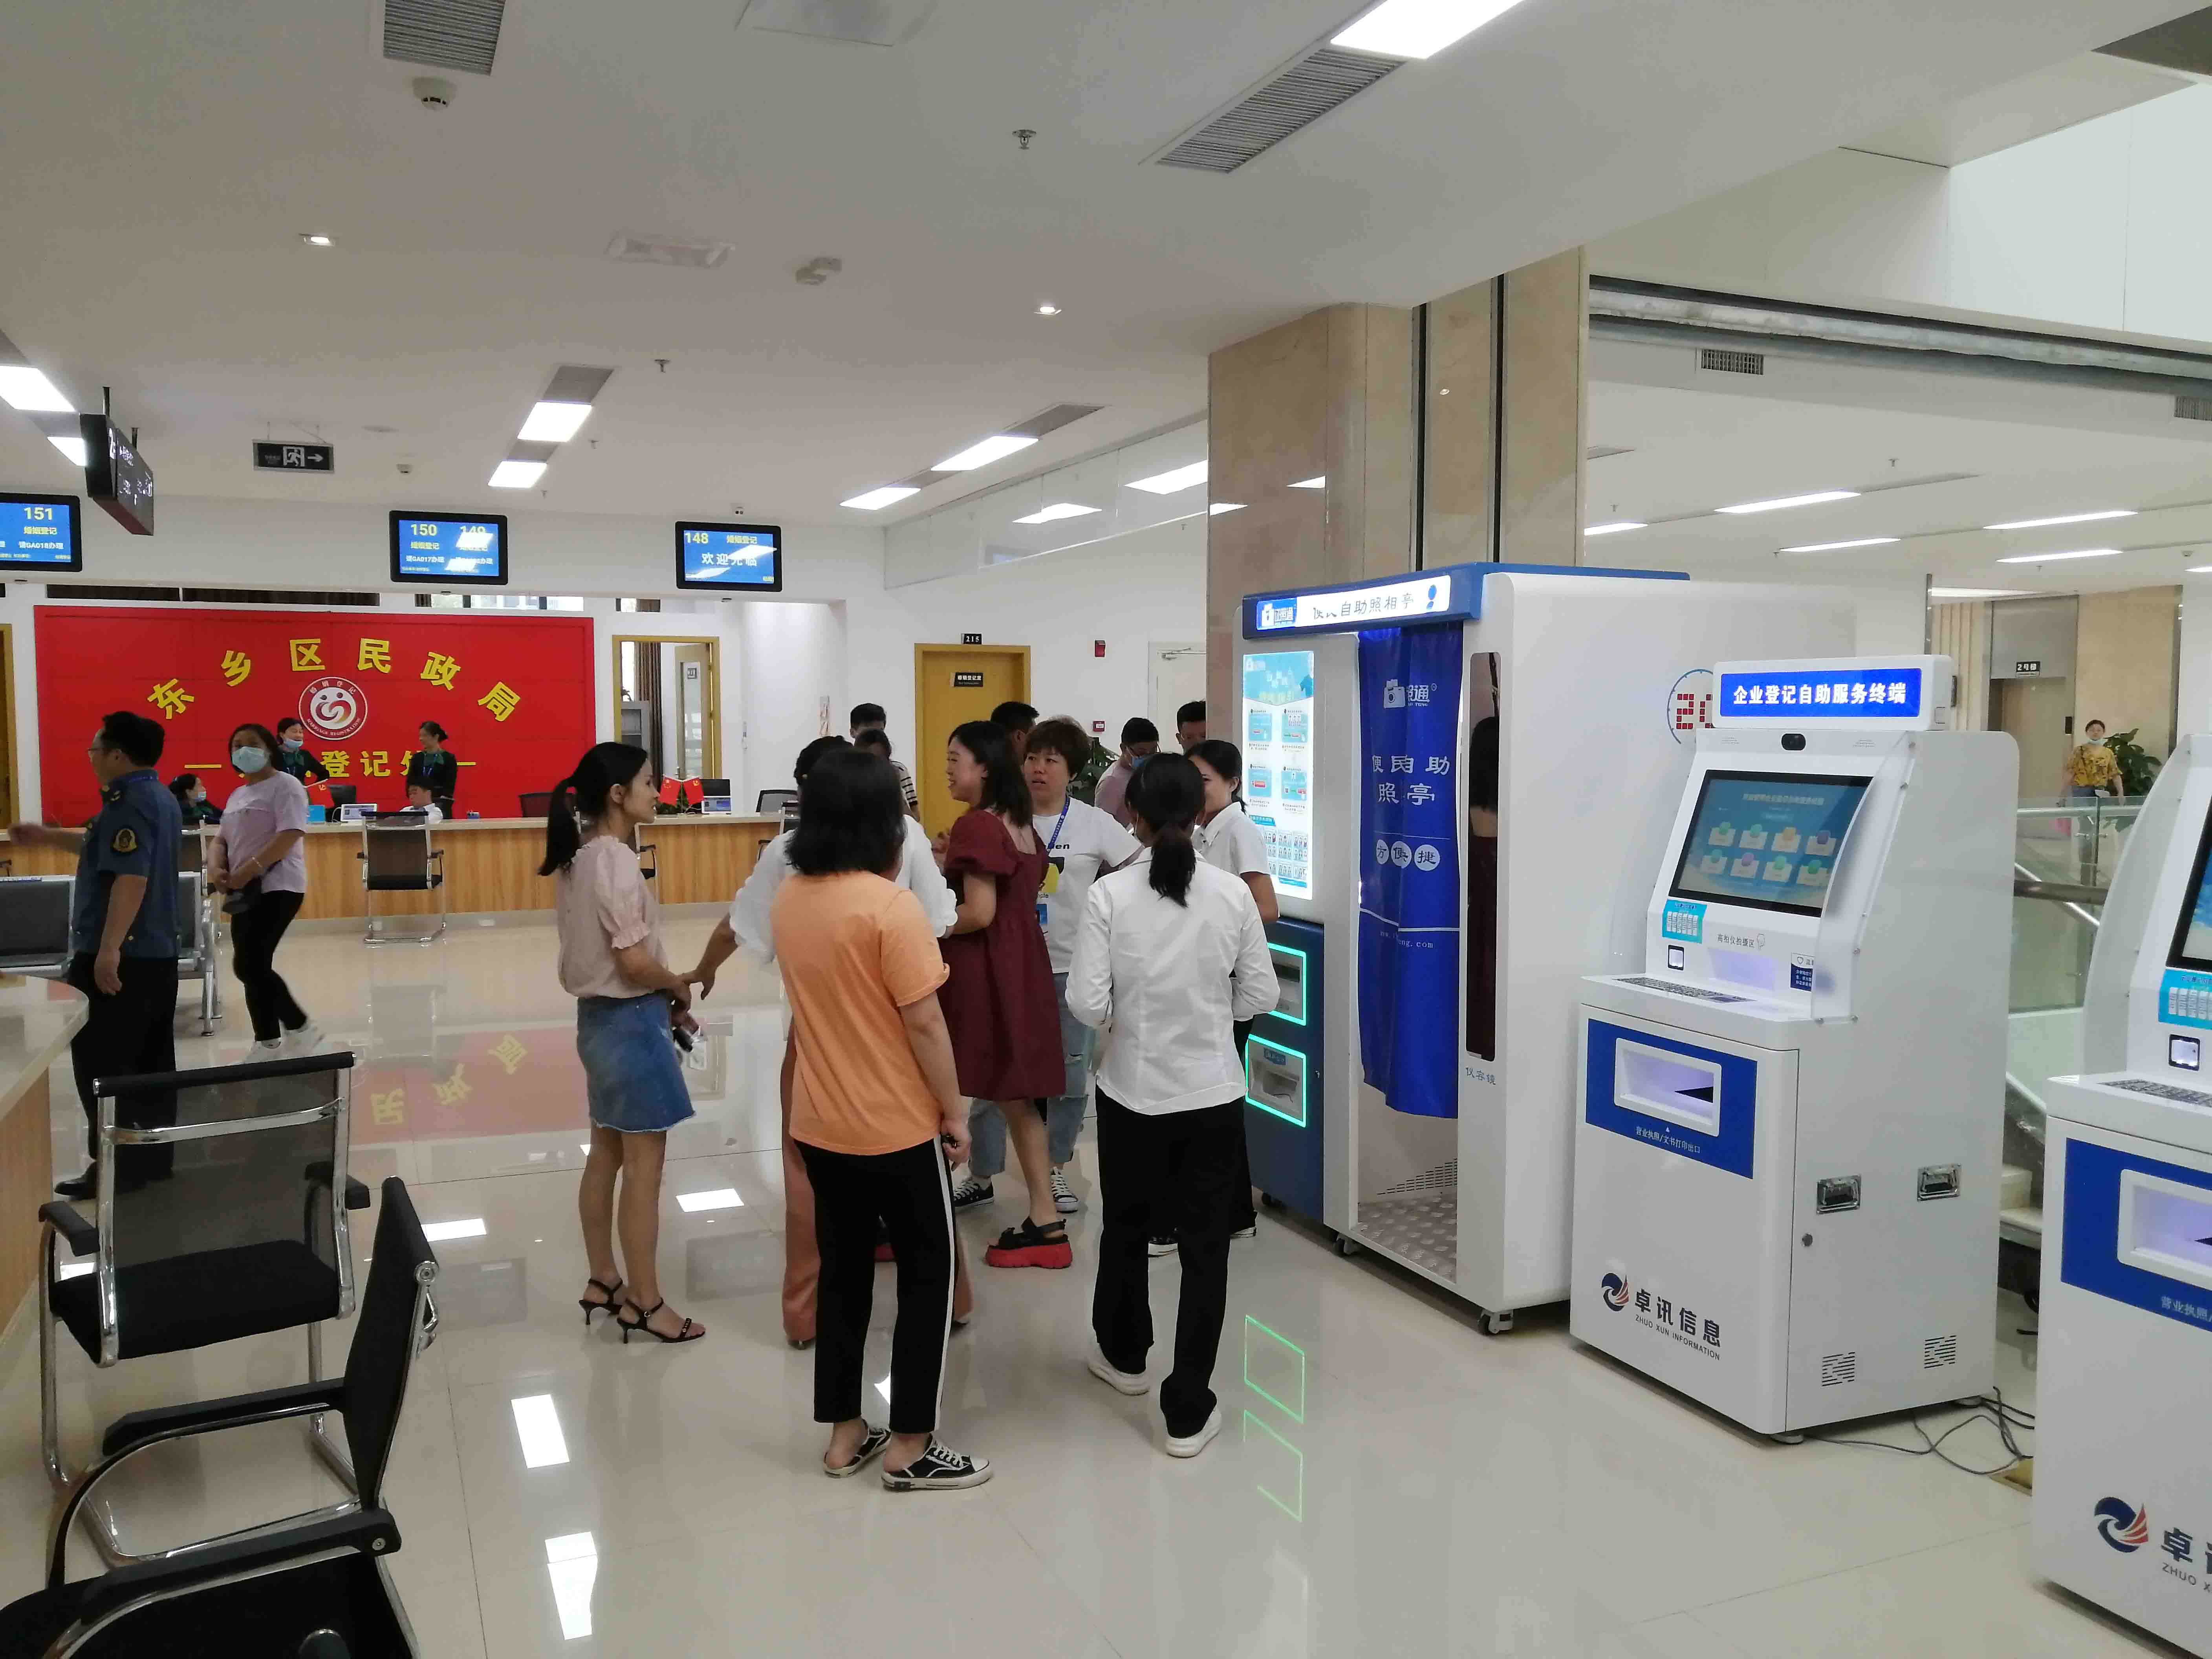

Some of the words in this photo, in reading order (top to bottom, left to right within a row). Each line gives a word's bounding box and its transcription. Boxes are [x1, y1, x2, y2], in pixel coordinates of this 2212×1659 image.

[24, 507, 53, 521] 151
[410, 524, 437, 536] 150
[685, 532, 709, 544] 148
[1733, 682, 1906, 705] 企业登记自助服务终端
[1635, 1288, 1720, 1348] 卓讯信息
[1635, 1314, 1653, 1328] ZHUO
[1656, 1324, 1669, 1336] XUN
[1672, 1332, 1720, 1361] INFORMATION
[2162, 1562, 2196, 1585] ZHUO
